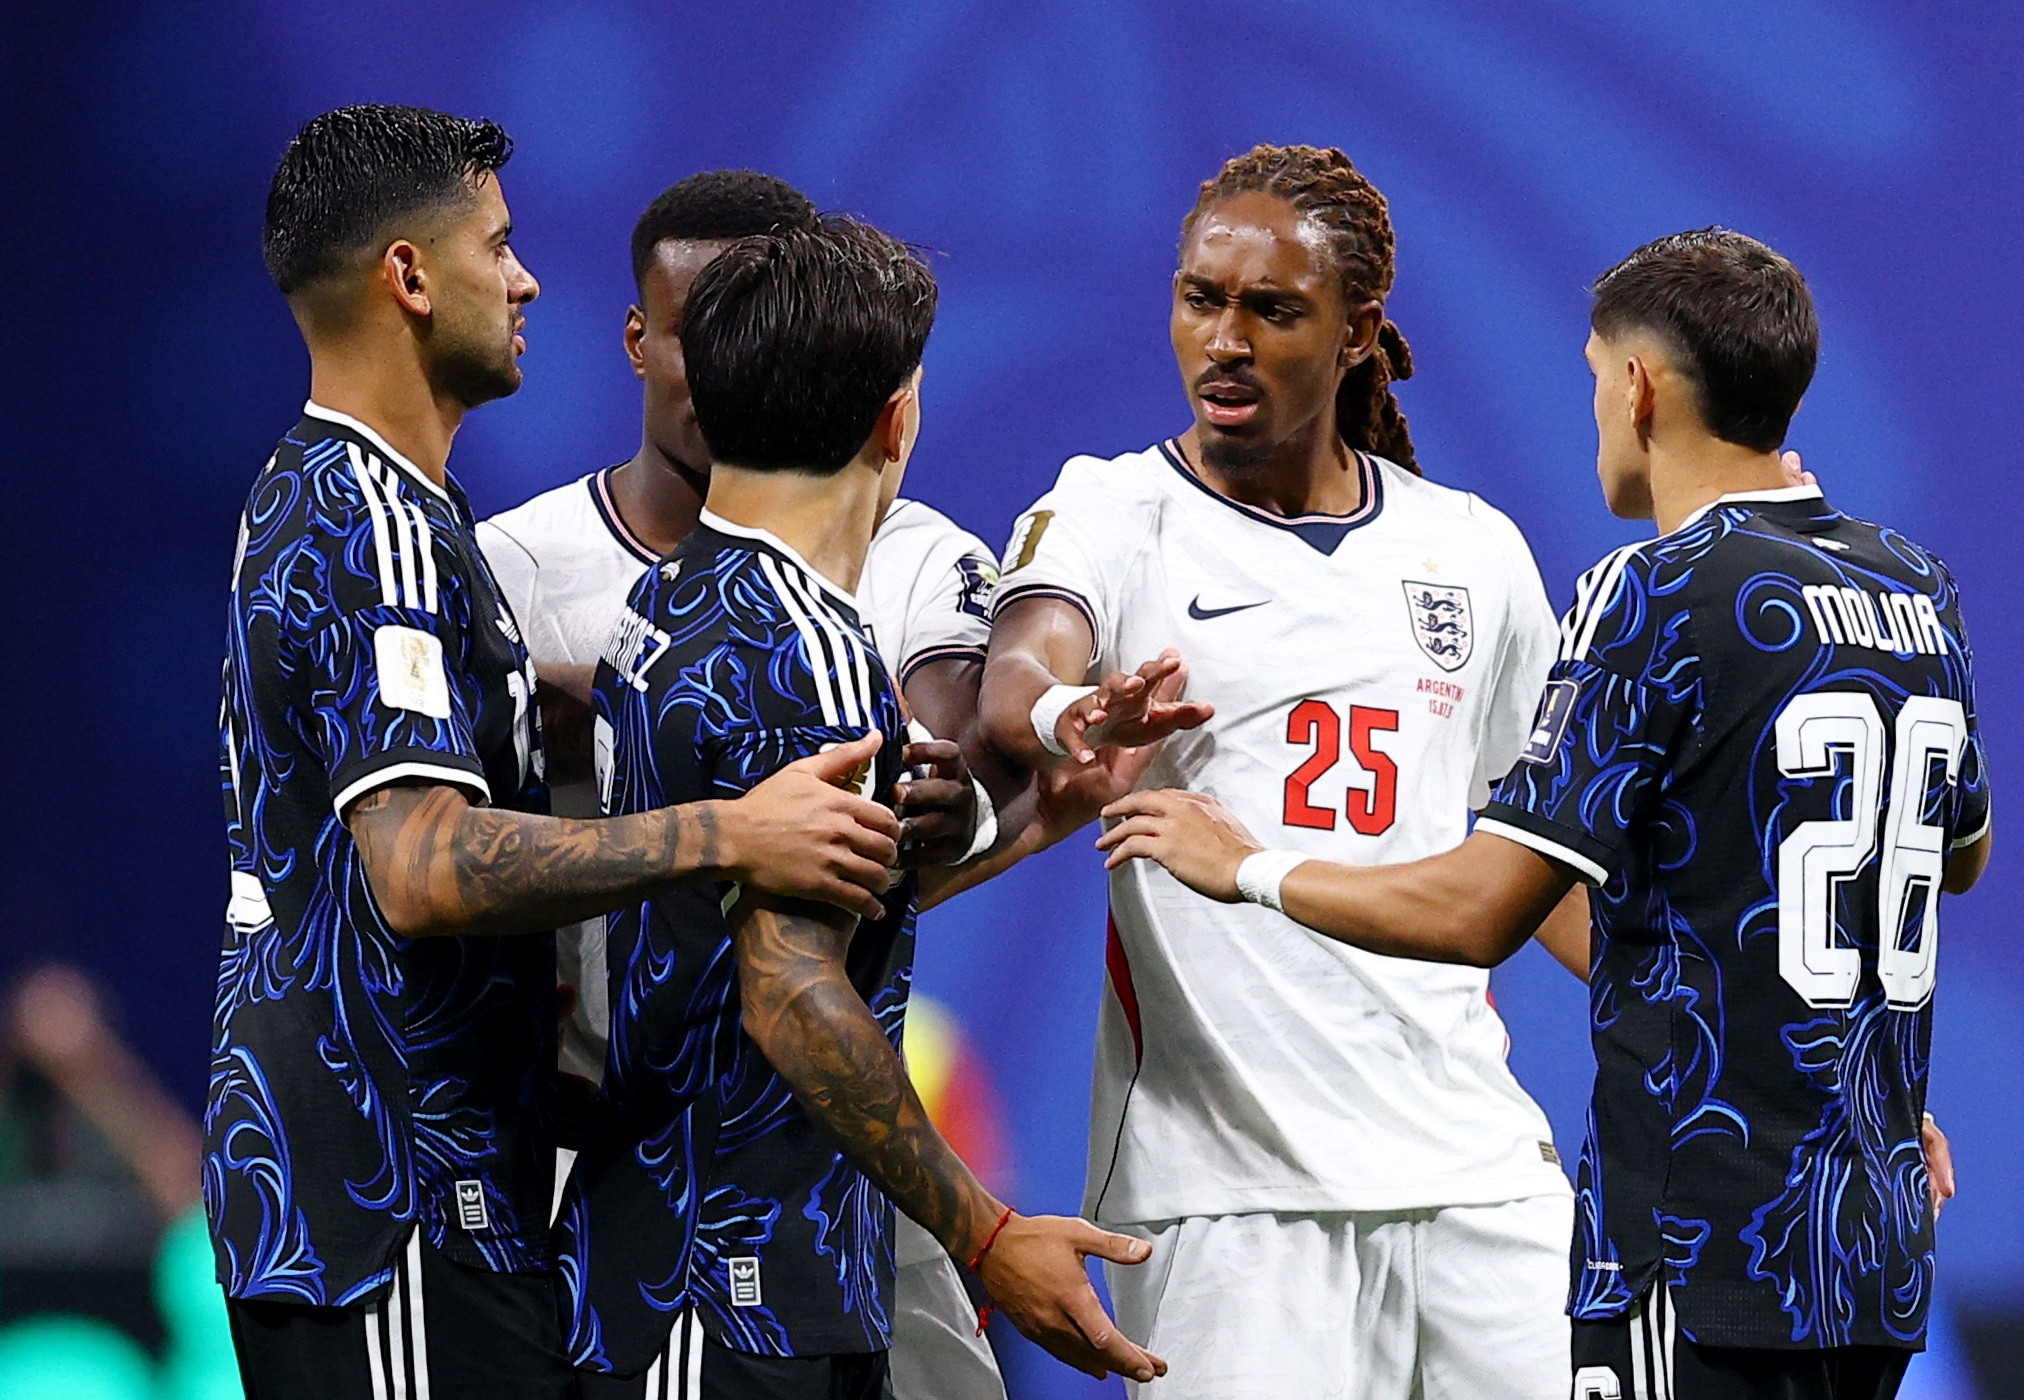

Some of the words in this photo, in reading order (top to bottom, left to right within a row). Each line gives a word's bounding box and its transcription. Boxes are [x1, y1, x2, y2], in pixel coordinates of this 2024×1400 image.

[1802, 585, 1949, 655] MOLINA
[1283, 699, 1399, 836] 25
[1775, 692, 1968, 1012] 26
